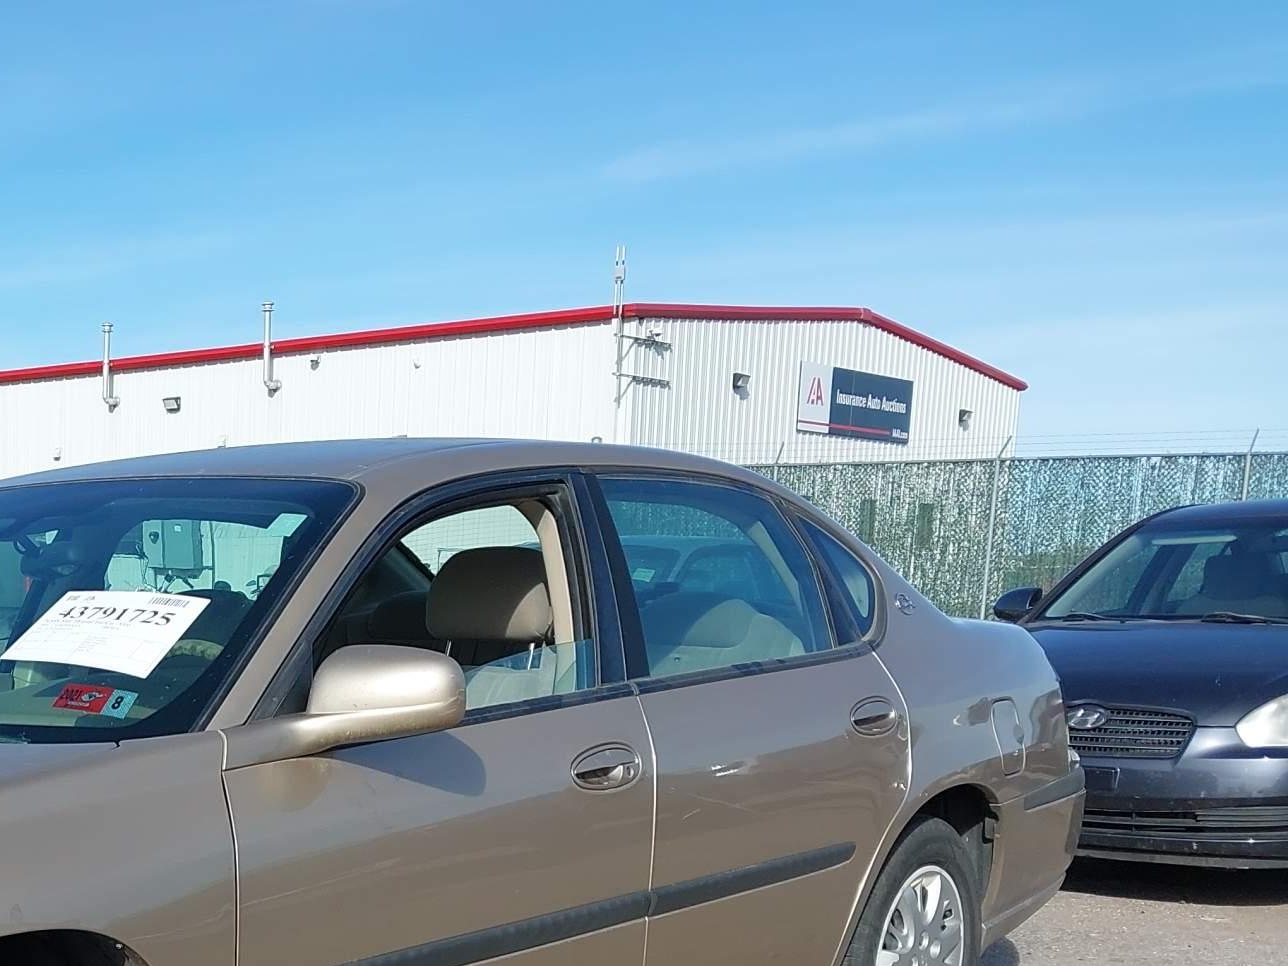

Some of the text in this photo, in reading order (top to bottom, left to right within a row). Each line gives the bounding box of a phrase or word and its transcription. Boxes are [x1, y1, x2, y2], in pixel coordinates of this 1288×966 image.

[836, 388, 907, 413] Insurance Auto Auctions
[59, 606, 176, 626] 43791725
[111, 695, 124, 710] 8
